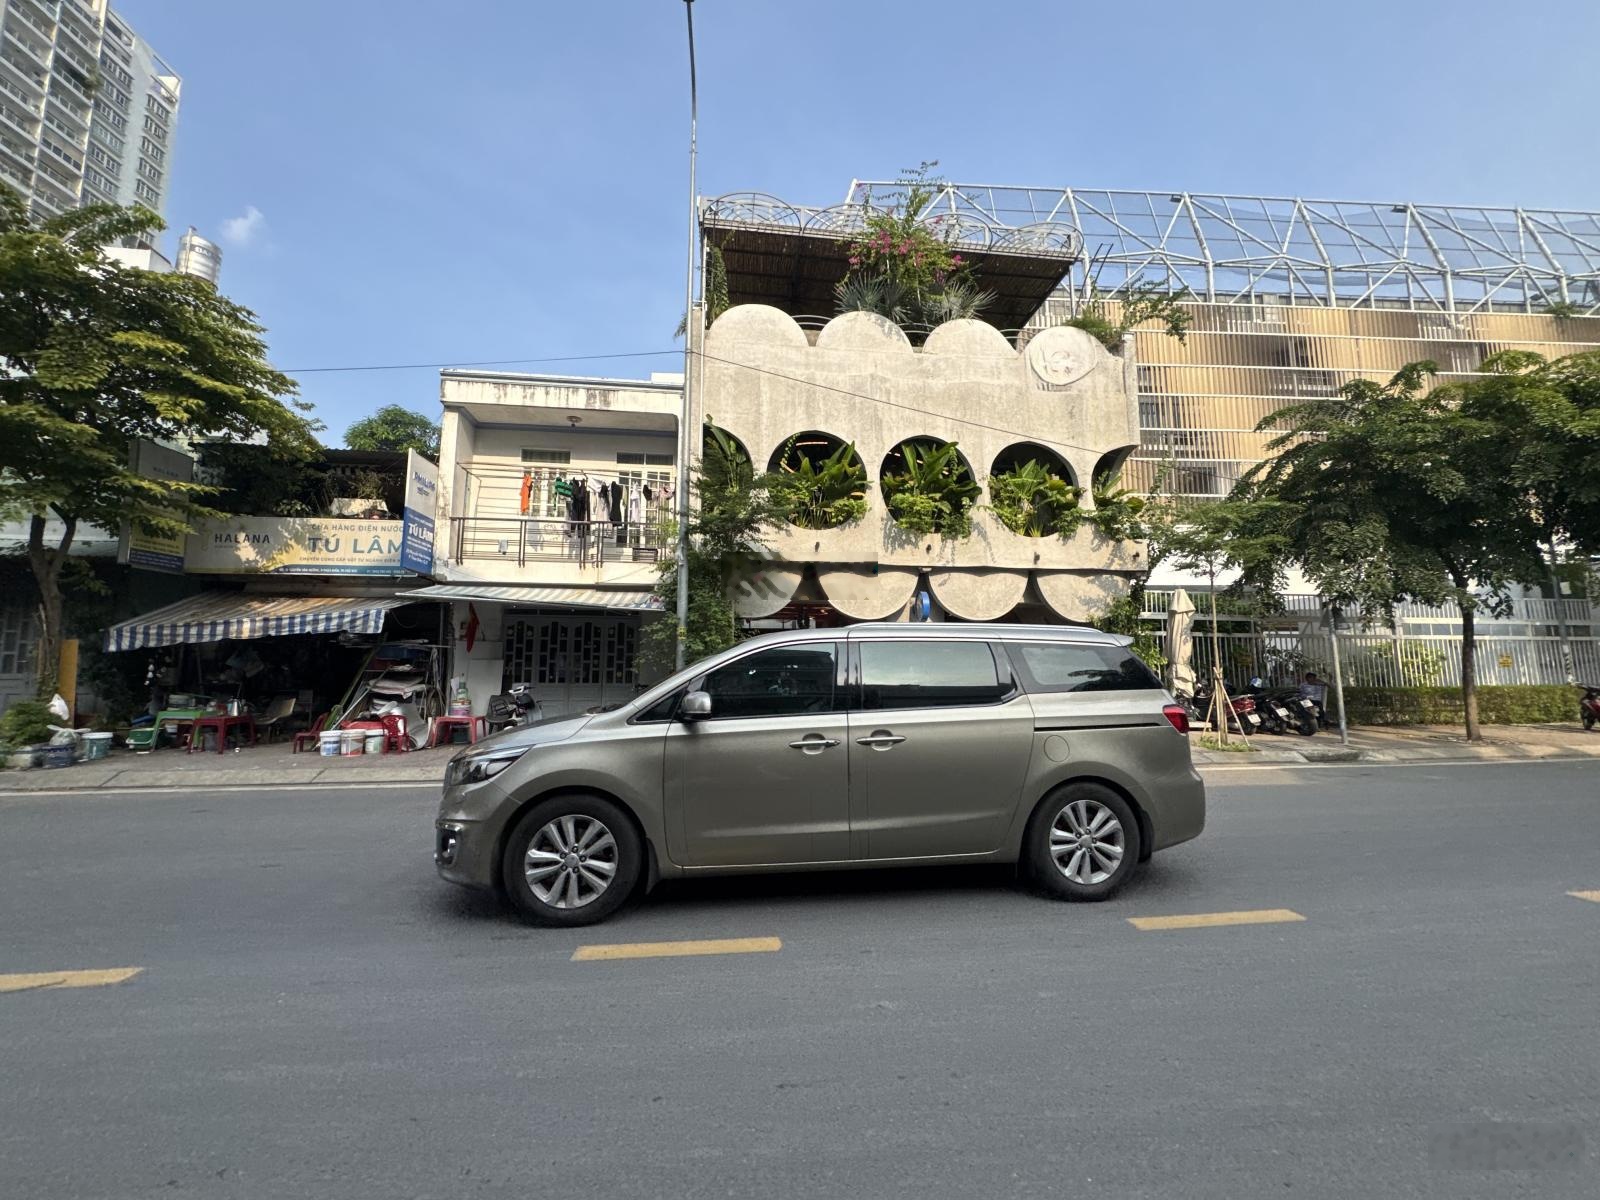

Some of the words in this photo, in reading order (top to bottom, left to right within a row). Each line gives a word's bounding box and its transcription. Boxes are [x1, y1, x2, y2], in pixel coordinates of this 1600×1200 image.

[331, 523, 356, 532] HÀNG
[408, 522, 419, 537] TÚ
[214, 533, 271, 544] HALANA
[308, 533, 340, 553] TÚ
[352, 534, 403, 554] LÂM
